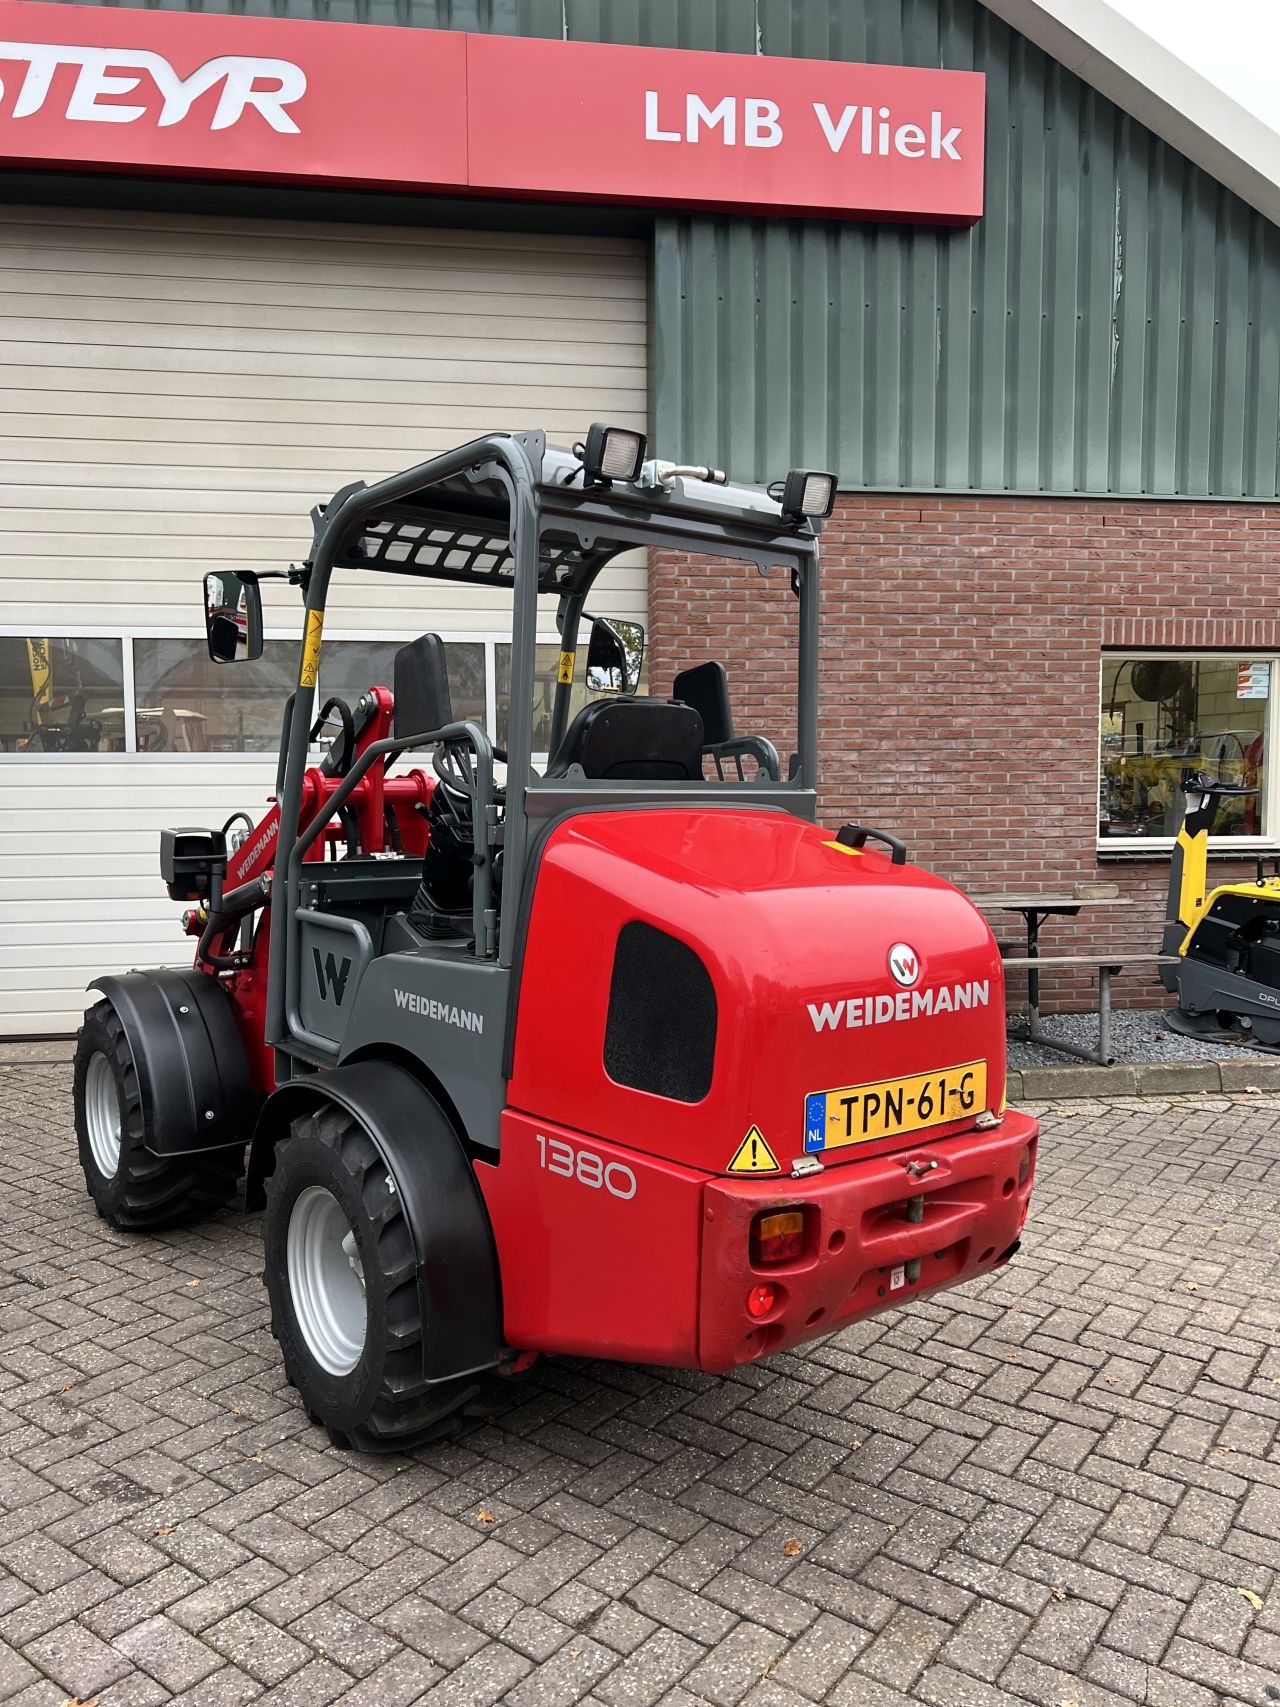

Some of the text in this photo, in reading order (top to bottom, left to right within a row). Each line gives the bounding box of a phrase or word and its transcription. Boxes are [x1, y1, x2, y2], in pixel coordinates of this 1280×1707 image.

[0, 42, 307, 134] TEYR
[645, 90, 963, 160] LMB Vliek
[237, 818, 279, 880] WEIDEMANN
[393, 988, 484, 1035] WEIDEMANN
[806, 979, 990, 1032] WEIDEMANN
[808, 1128, 823, 1143] NL
[840, 1072, 974, 1136] TPN-61-G
[536, 1134, 637, 1200] 1380
